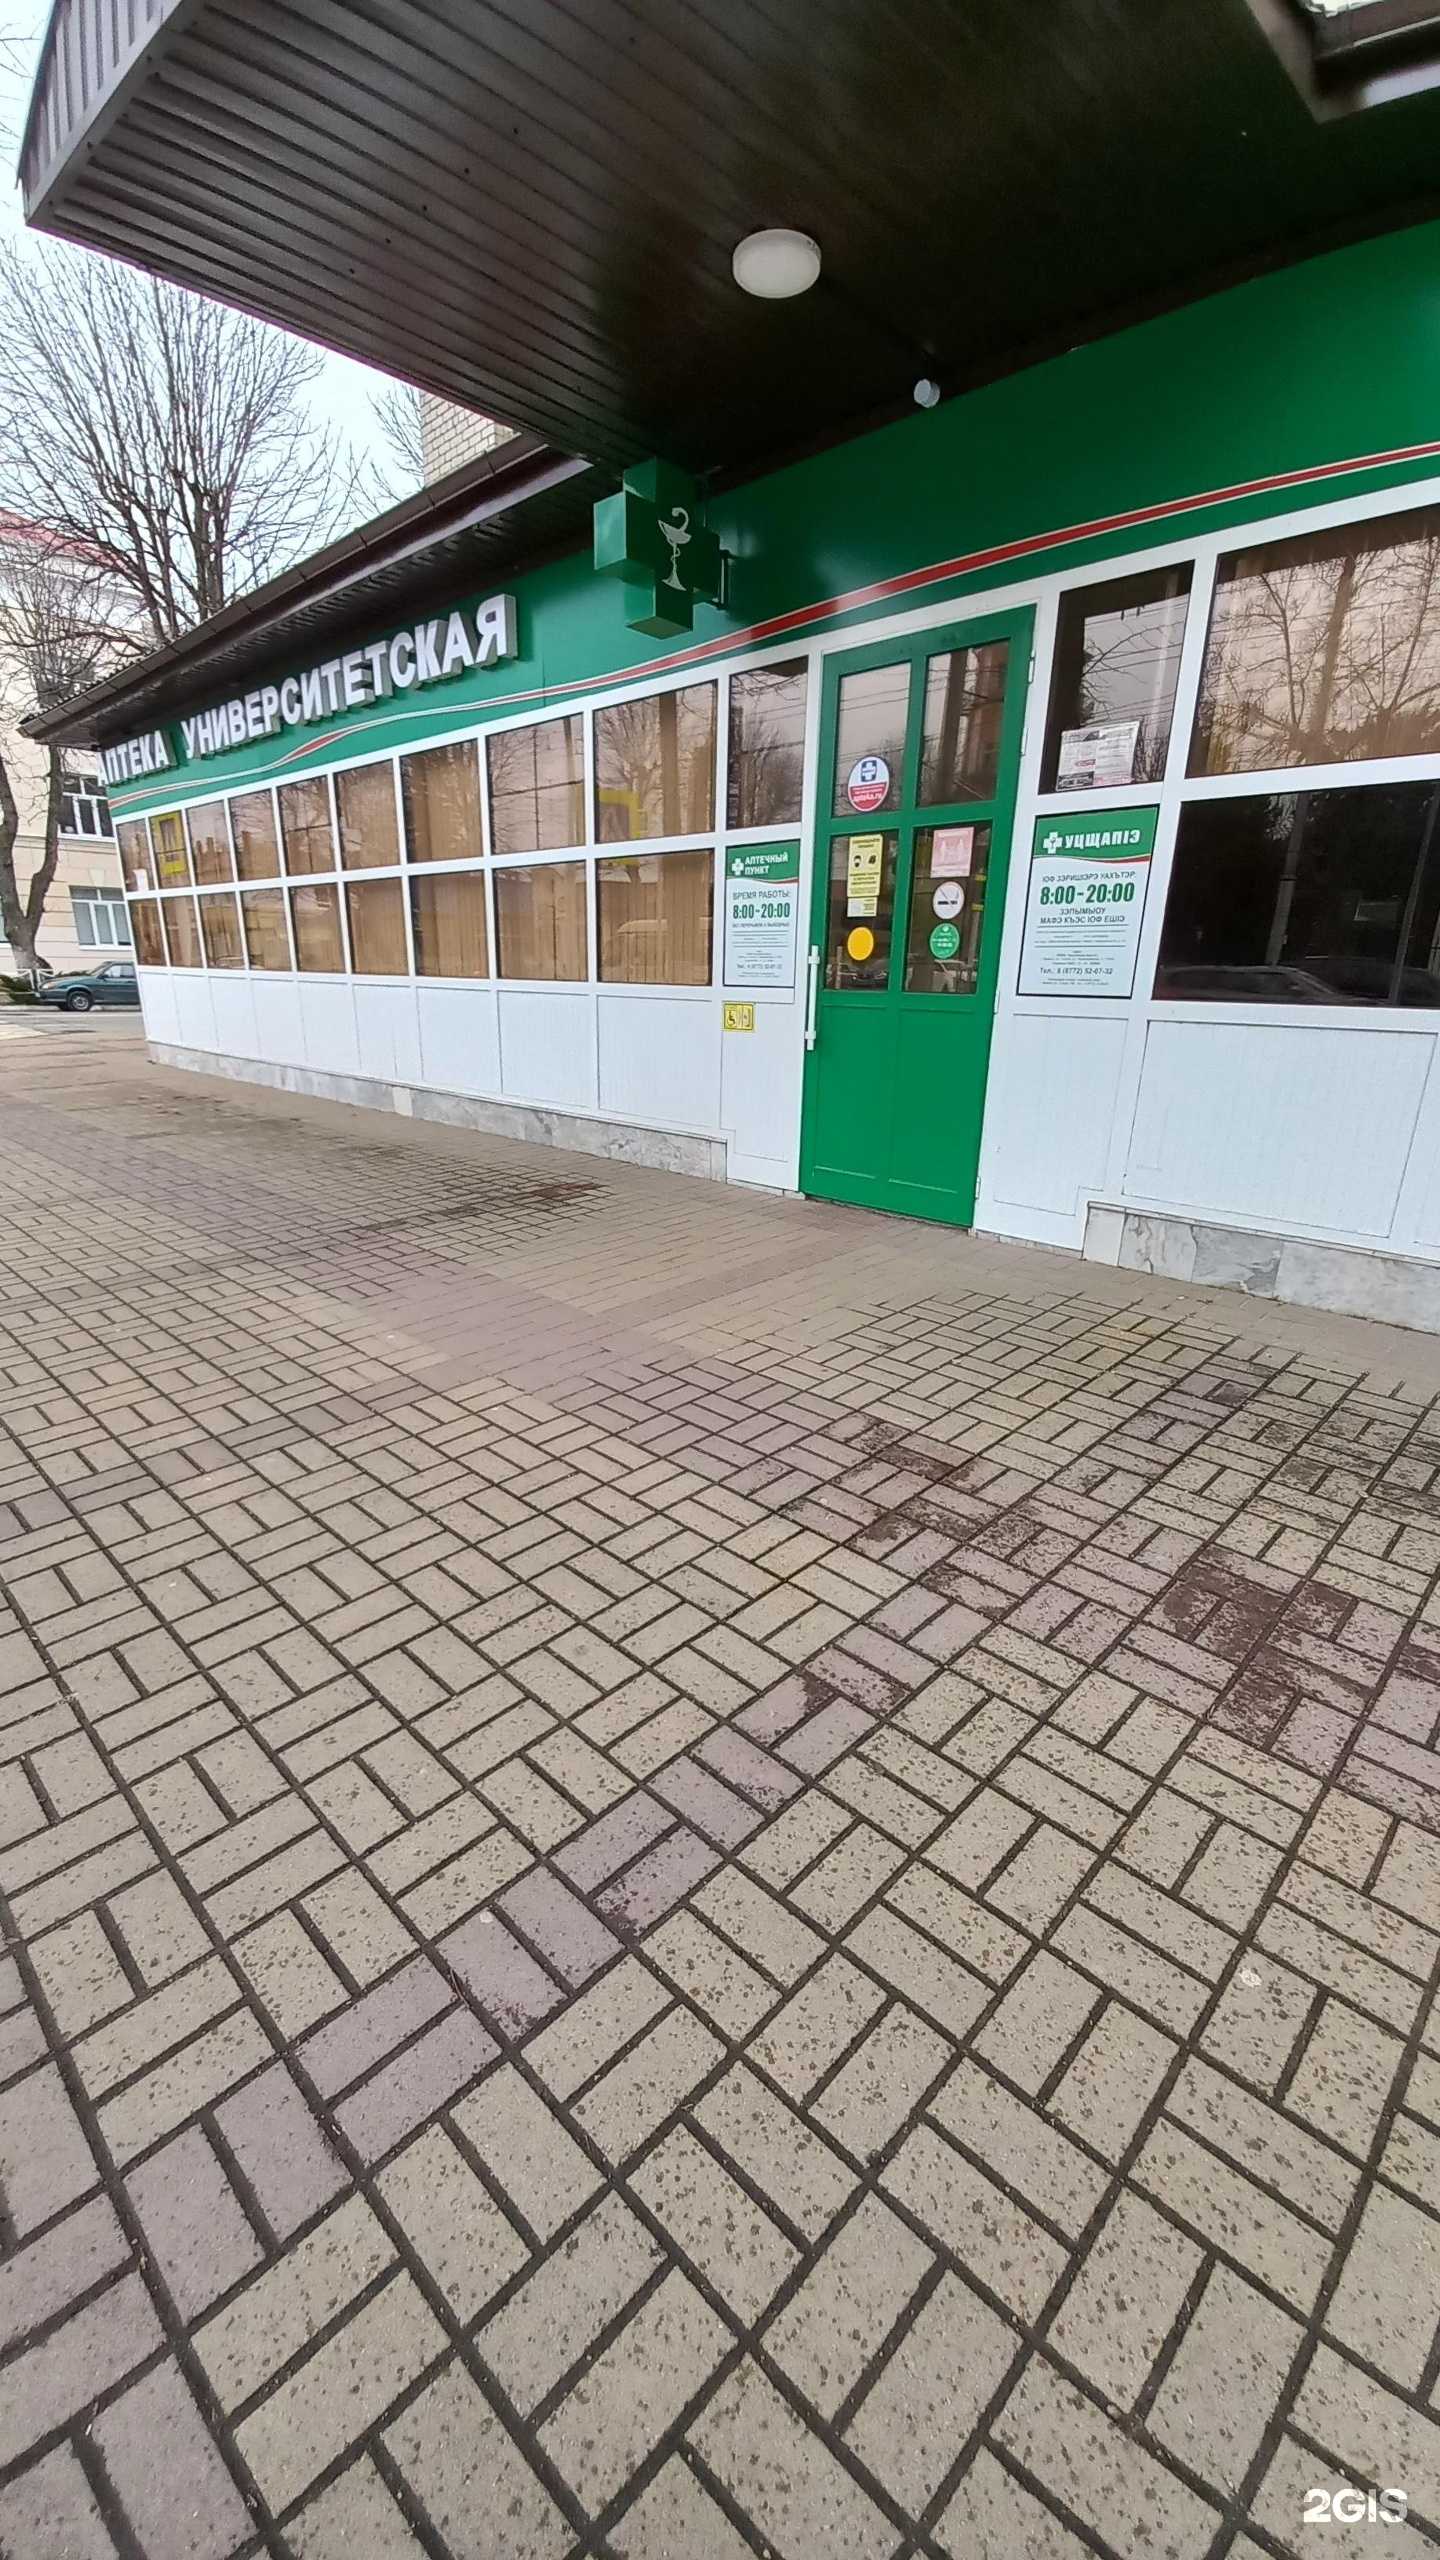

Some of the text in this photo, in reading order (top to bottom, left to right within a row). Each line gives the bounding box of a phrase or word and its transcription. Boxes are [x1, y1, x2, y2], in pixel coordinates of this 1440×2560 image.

[96, 594, 512, 788] АПТЕКА УНИВЕРСИТЕТСКАЯ
[744, 852, 789, 866] АПТЕЧНЫЙ
[744, 865, 769, 875] ПУНКТ
[733, 891, 757, 900] ВРЕМЯ
